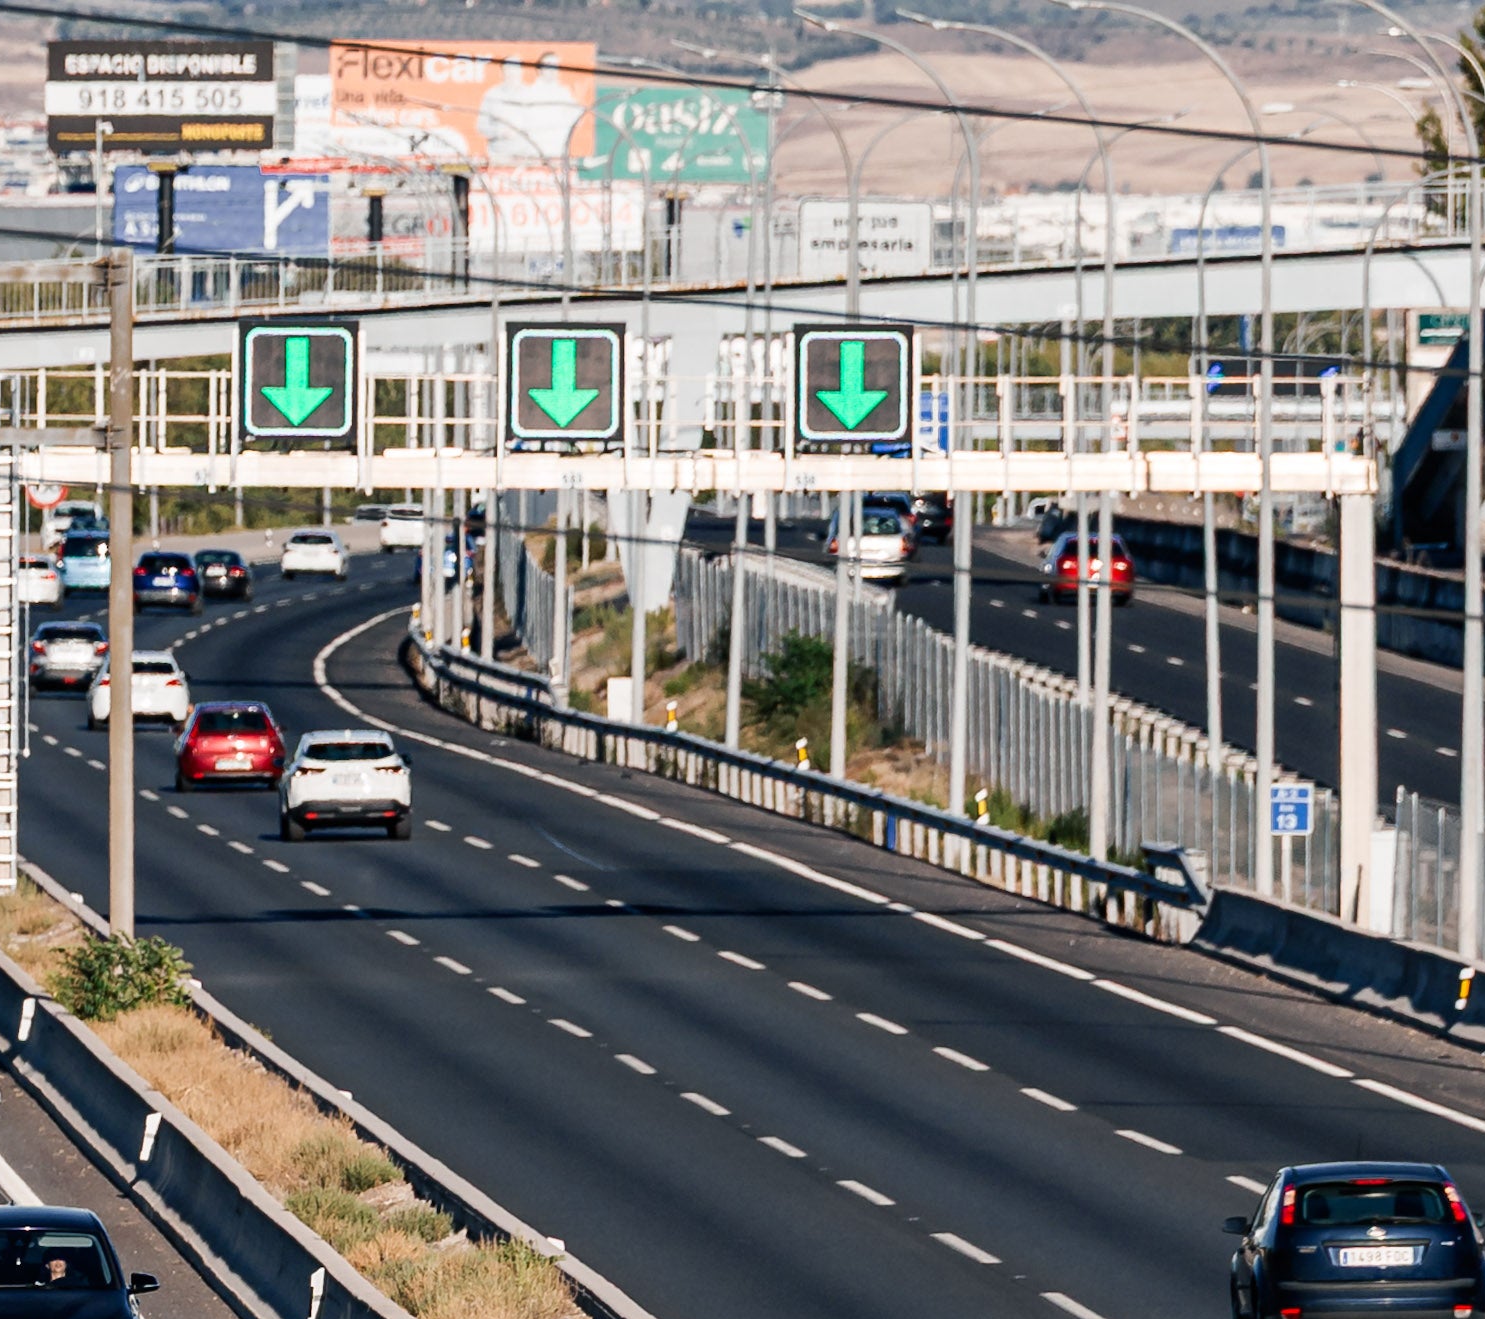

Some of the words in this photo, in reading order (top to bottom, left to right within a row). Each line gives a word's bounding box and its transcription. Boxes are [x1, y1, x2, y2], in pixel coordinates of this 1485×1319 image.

[64, 53, 144, 75] ESPACIO
[147, 53, 258, 76] DISPONIBLE
[79, 89, 126, 109] 918
[137, 89, 184, 109] 415
[196, 89, 242, 109] 505
